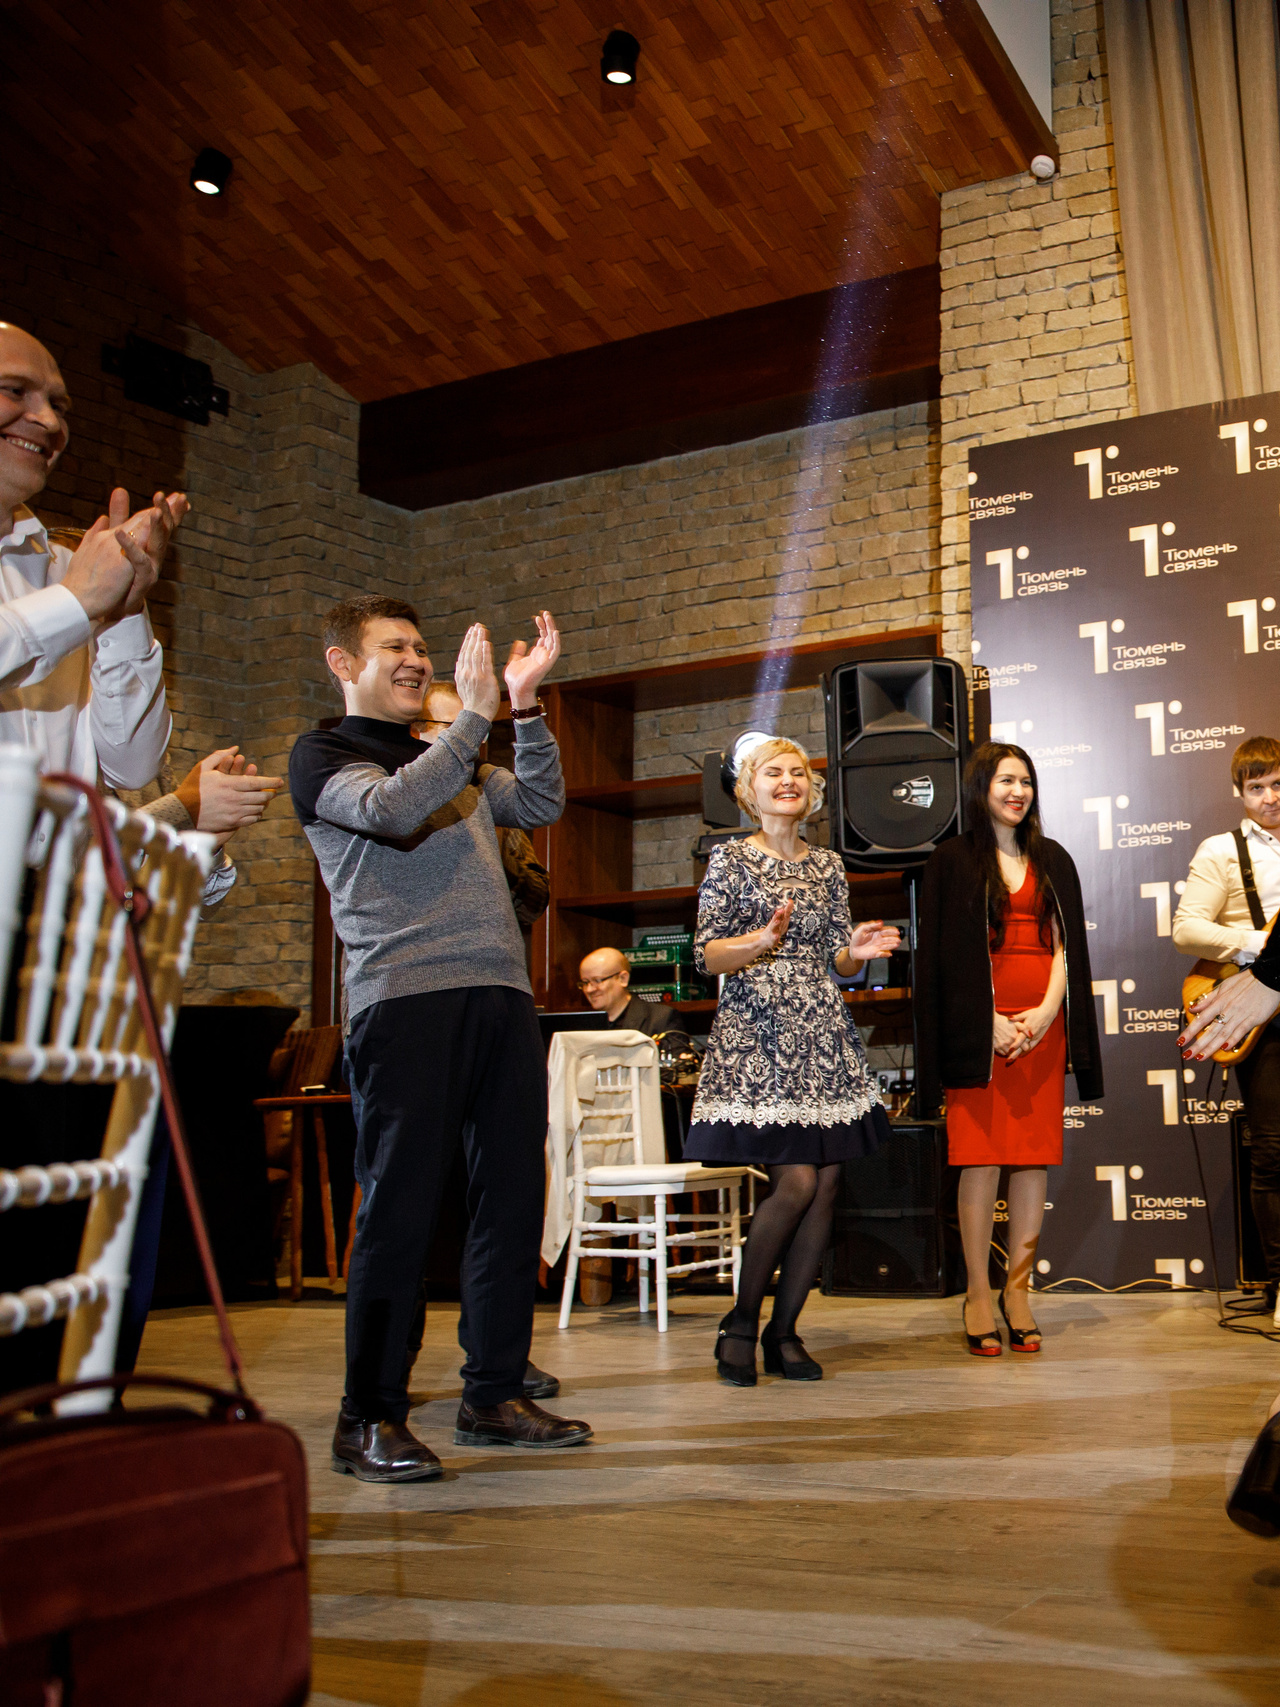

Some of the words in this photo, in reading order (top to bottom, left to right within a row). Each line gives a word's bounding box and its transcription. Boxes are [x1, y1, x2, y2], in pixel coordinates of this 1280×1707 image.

[1107, 466, 1179, 484] Тюмень
[1107, 479, 1161, 496] связь
[1163, 543, 1238, 563] Тюмень
[1163, 557, 1219, 574] связь
[1017, 567, 1086, 585] Тюмень
[1018, 580, 1069, 597] связь
[1113, 642, 1185, 660] Тюмень
[1113, 655, 1167, 671] связь
[1170, 724, 1245, 743] Тюмень
[1170, 738, 1226, 754] связь
[1118, 820, 1191, 837] Тюмень
[1118, 833, 1172, 849] связь
[1123, 1022, 1179, 1033] связь
[1130, 1195, 1206, 1209] Тюмень
[1132, 1208, 1187, 1220] связь
